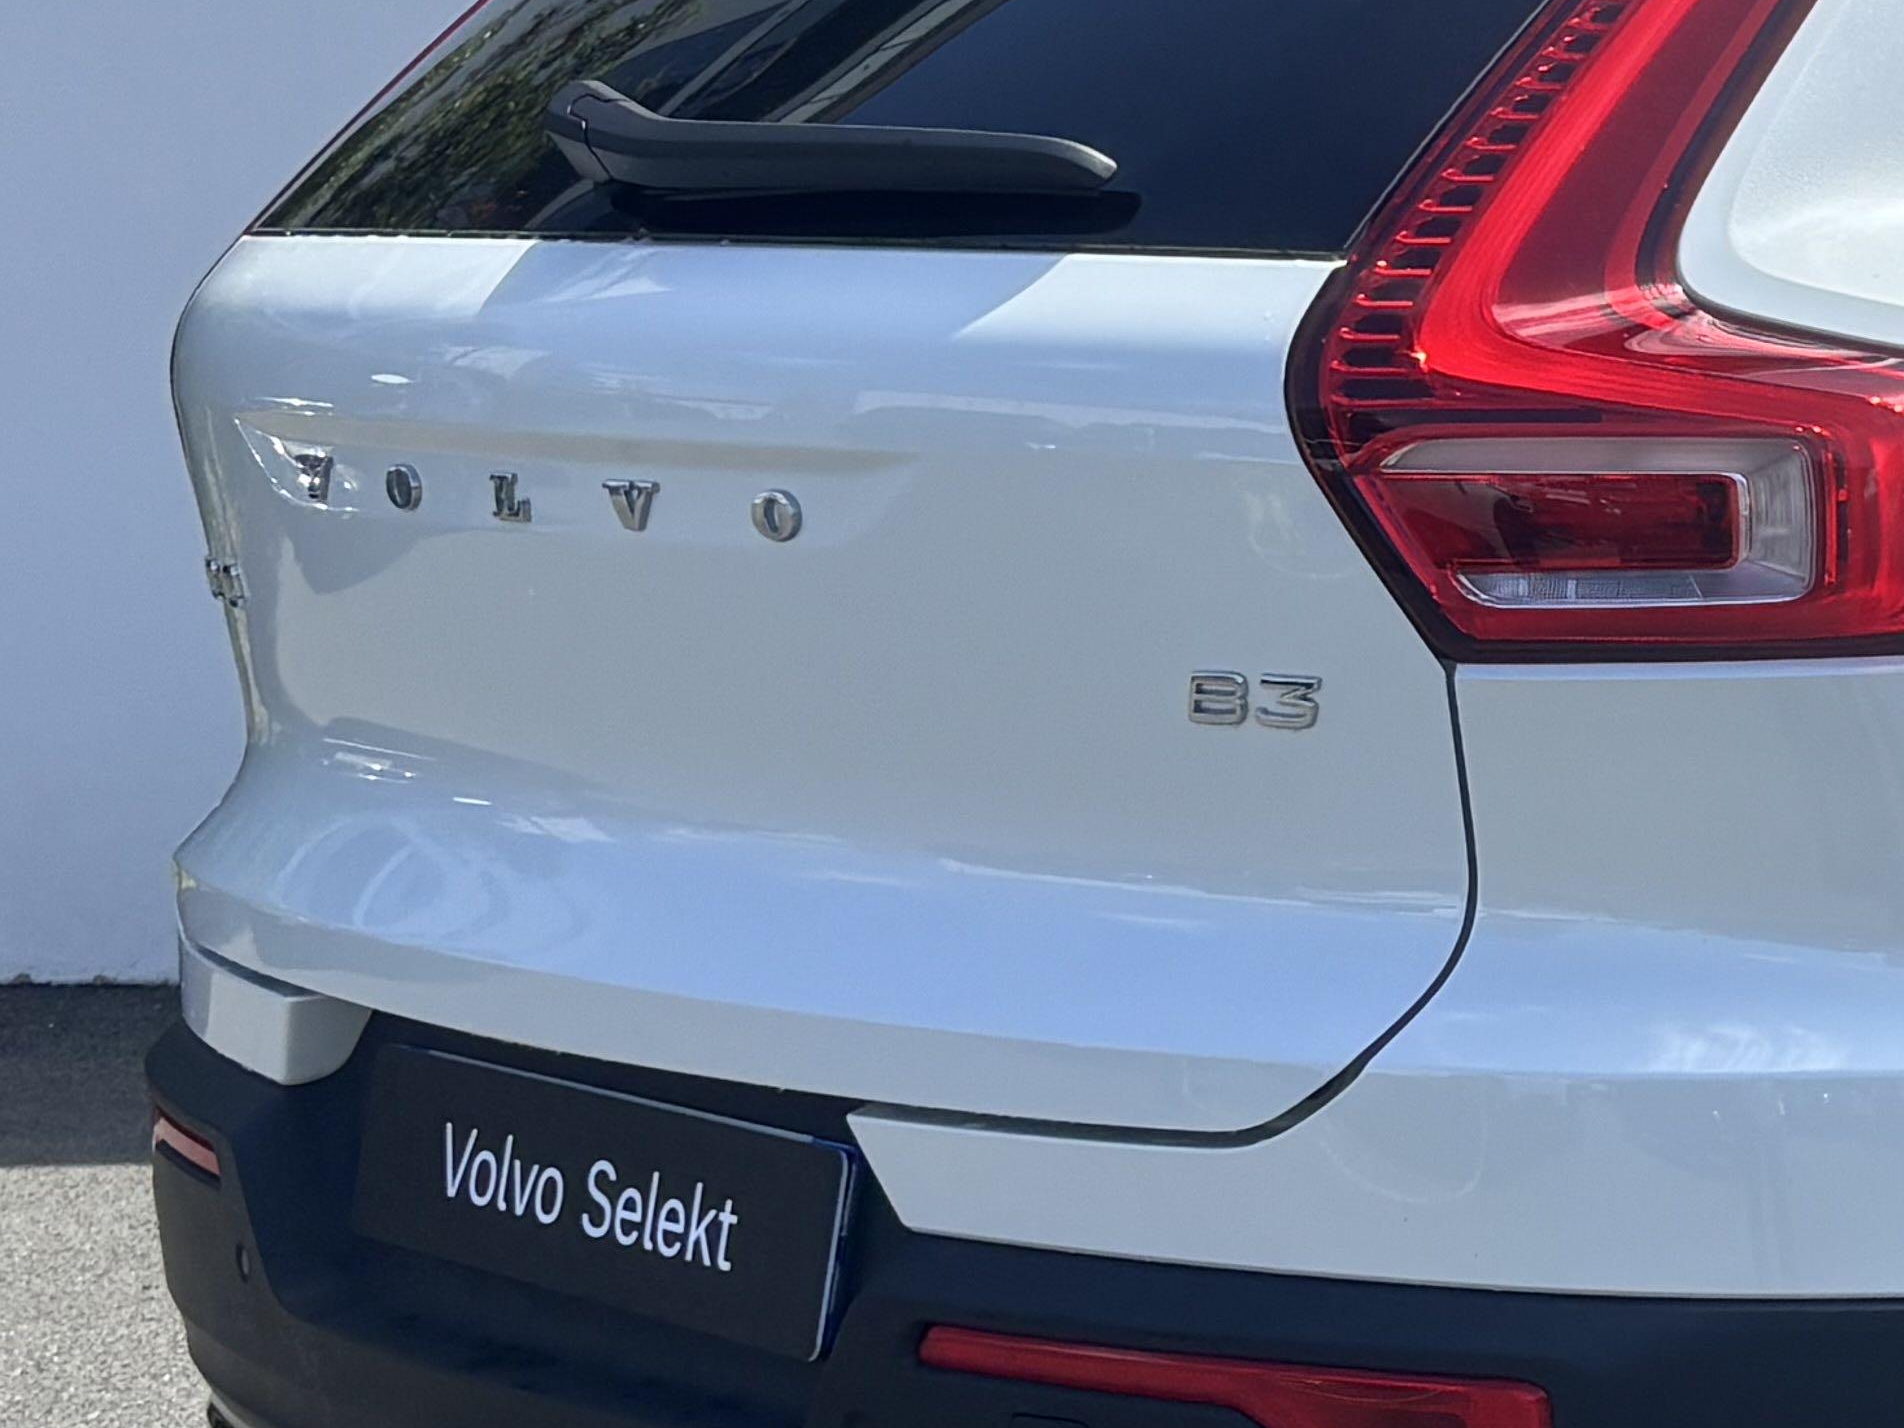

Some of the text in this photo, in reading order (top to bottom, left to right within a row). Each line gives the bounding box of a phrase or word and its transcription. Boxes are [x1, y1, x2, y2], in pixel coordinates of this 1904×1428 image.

[292, 450, 802, 542] VOLVO
[1187, 671, 1323, 730] B3
[444, 1122, 738, 1271] Volvo Selekt
